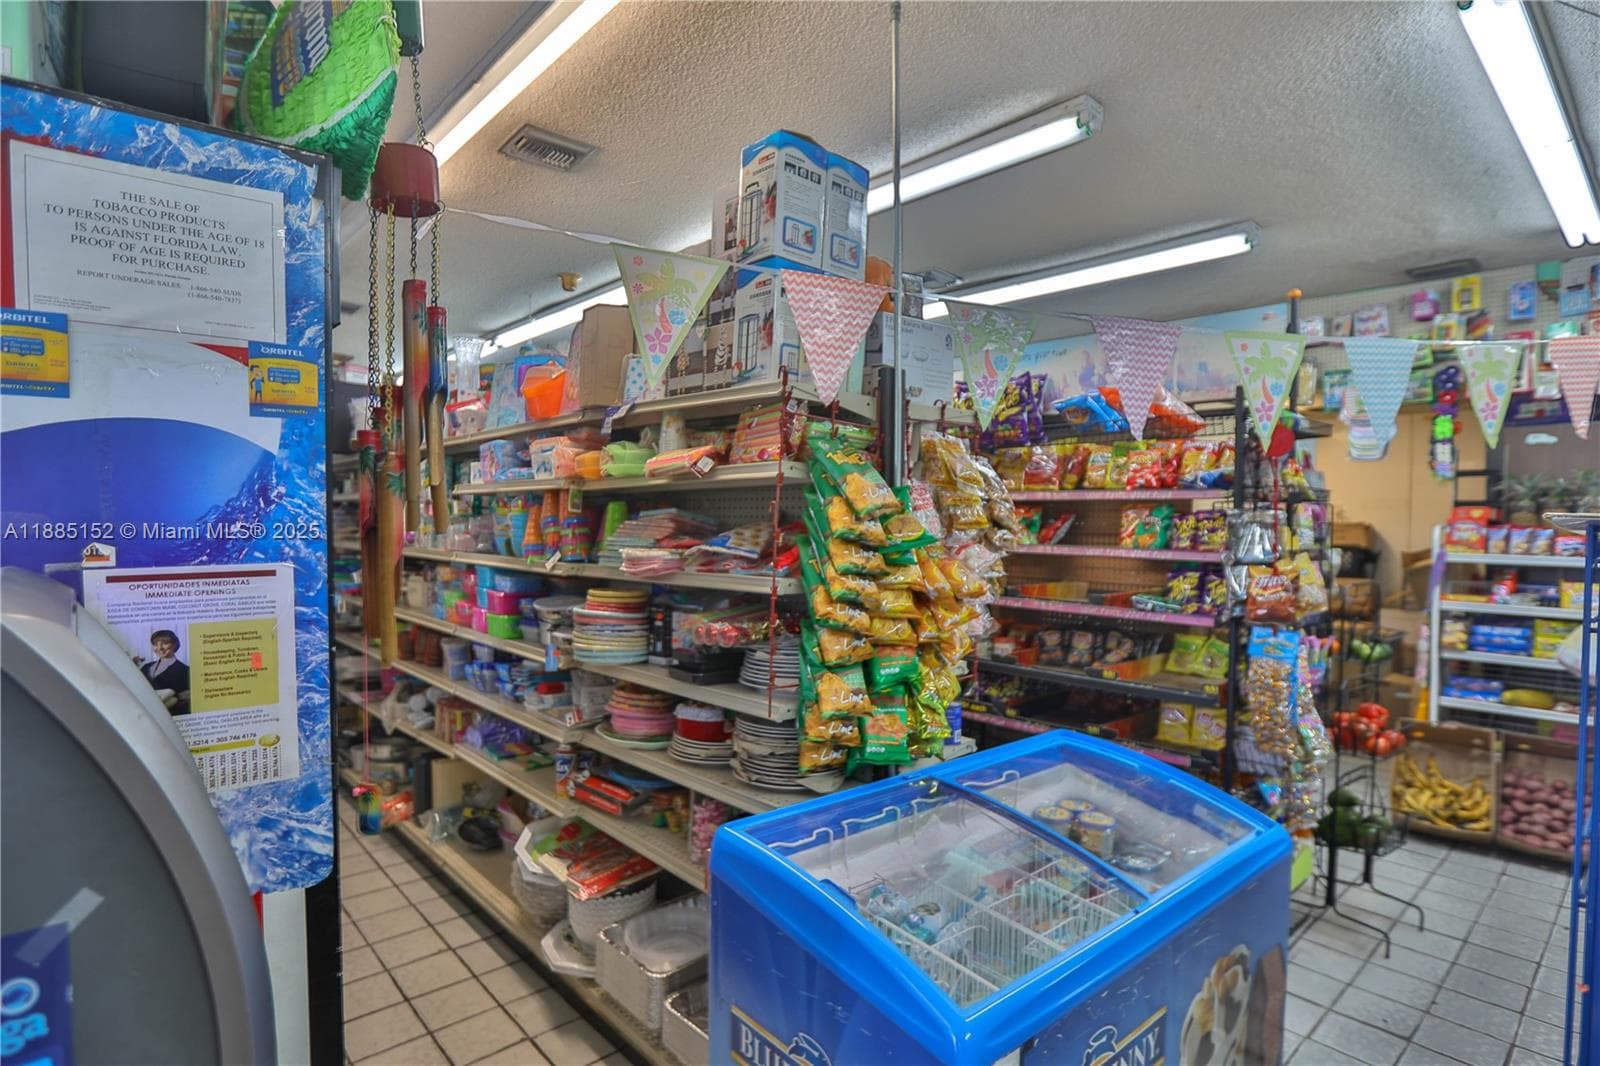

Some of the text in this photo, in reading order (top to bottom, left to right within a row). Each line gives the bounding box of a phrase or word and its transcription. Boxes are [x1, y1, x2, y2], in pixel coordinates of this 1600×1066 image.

[120, 191, 200, 214] THE SALE OF
[44, 203, 265, 248] TO PERSONS UNDER THE AGE OF 18
[92, 199, 226, 230] TOBACCO PRODUCTS
[74, 221, 242, 256] IS AGAINST FLORIDA LAW.
[71, 234, 246, 269] PROOF OF AGE IS REQUIRED
[112, 253, 139, 265] FOR
[142, 258, 210, 276] PURCHASE.
[76, 269, 109, 279] REPORT
[111, 273, 156, 286] UNDERAGE
[157, 280, 181, 288] SALES
[261, 344, 305, 357] ORBITEL
[128, 579, 250, 591] OPORTUNIDADES INMEDIATAS
[146, 588, 236, 599] IMMEDIATE OPENINGS
